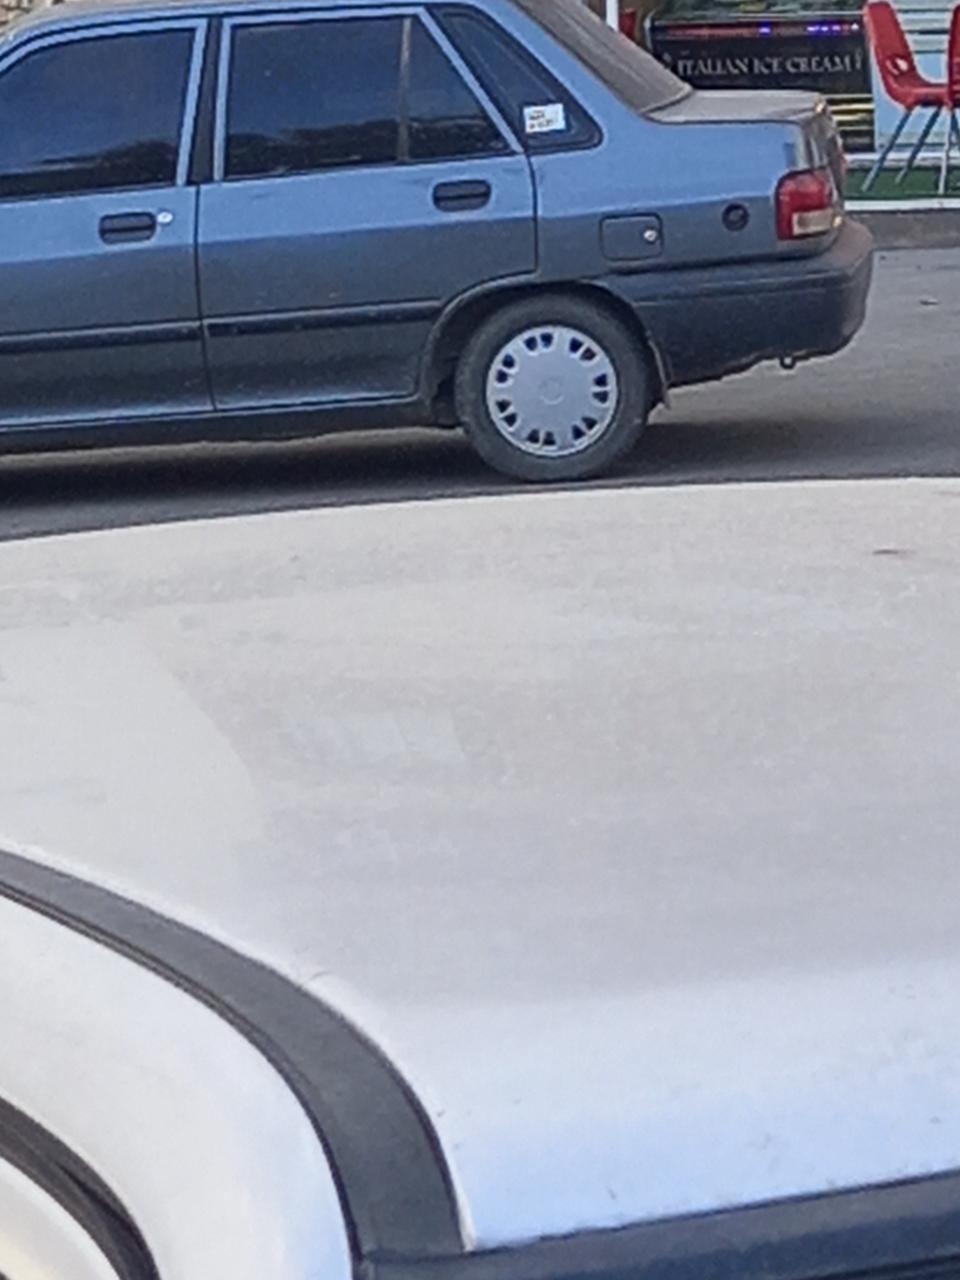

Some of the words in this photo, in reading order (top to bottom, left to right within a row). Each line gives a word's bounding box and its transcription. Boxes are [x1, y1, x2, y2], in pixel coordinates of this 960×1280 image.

[677, 56, 749, 77] ITALIAN
[753, 56, 783, 75] ICE
[785, 54, 853, 75] CREAM
